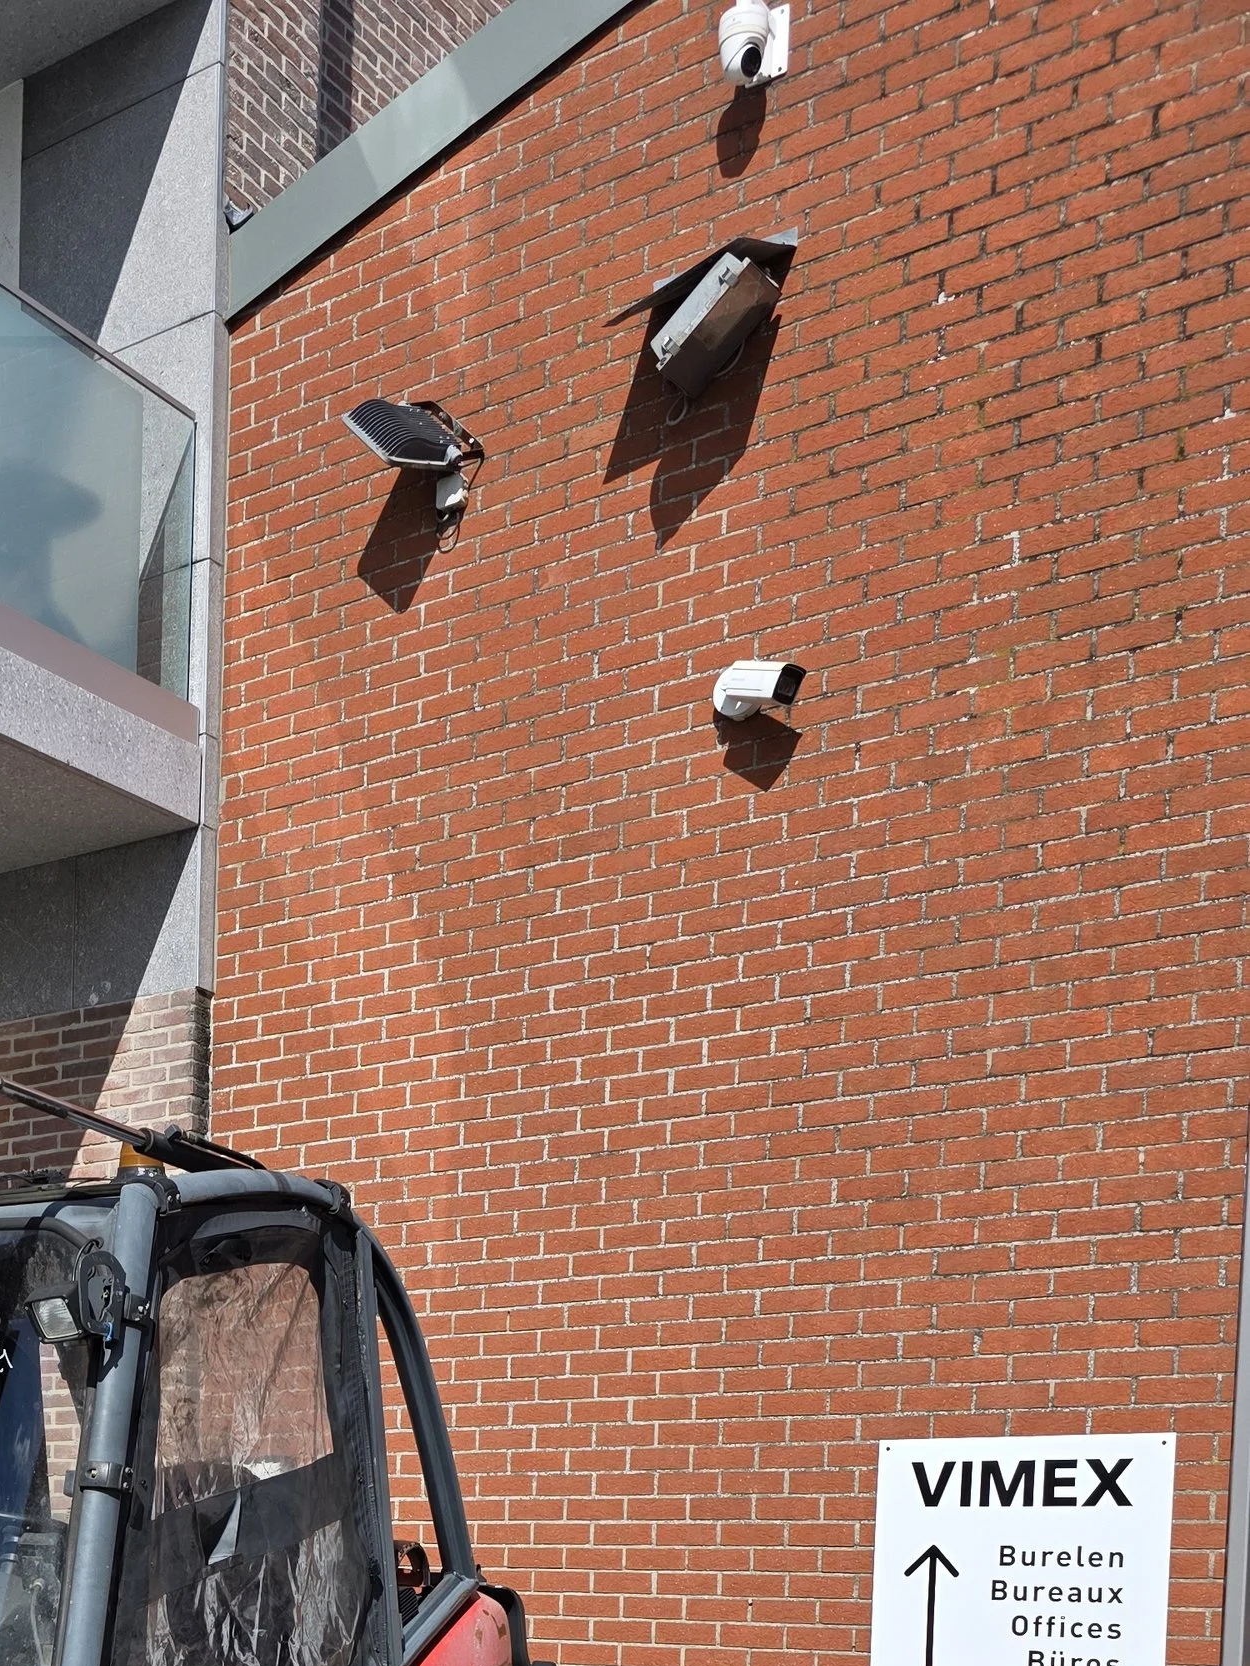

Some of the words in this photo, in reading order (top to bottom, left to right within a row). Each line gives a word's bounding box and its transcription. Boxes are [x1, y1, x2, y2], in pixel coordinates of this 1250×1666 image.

[912, 1458, 1133, 1507] VIMEX
[1000, 1546, 1123, 1567] Burelen
[992, 1580, 1122, 1603] Bureaux
[1012, 1616, 1121, 1639] Offices
